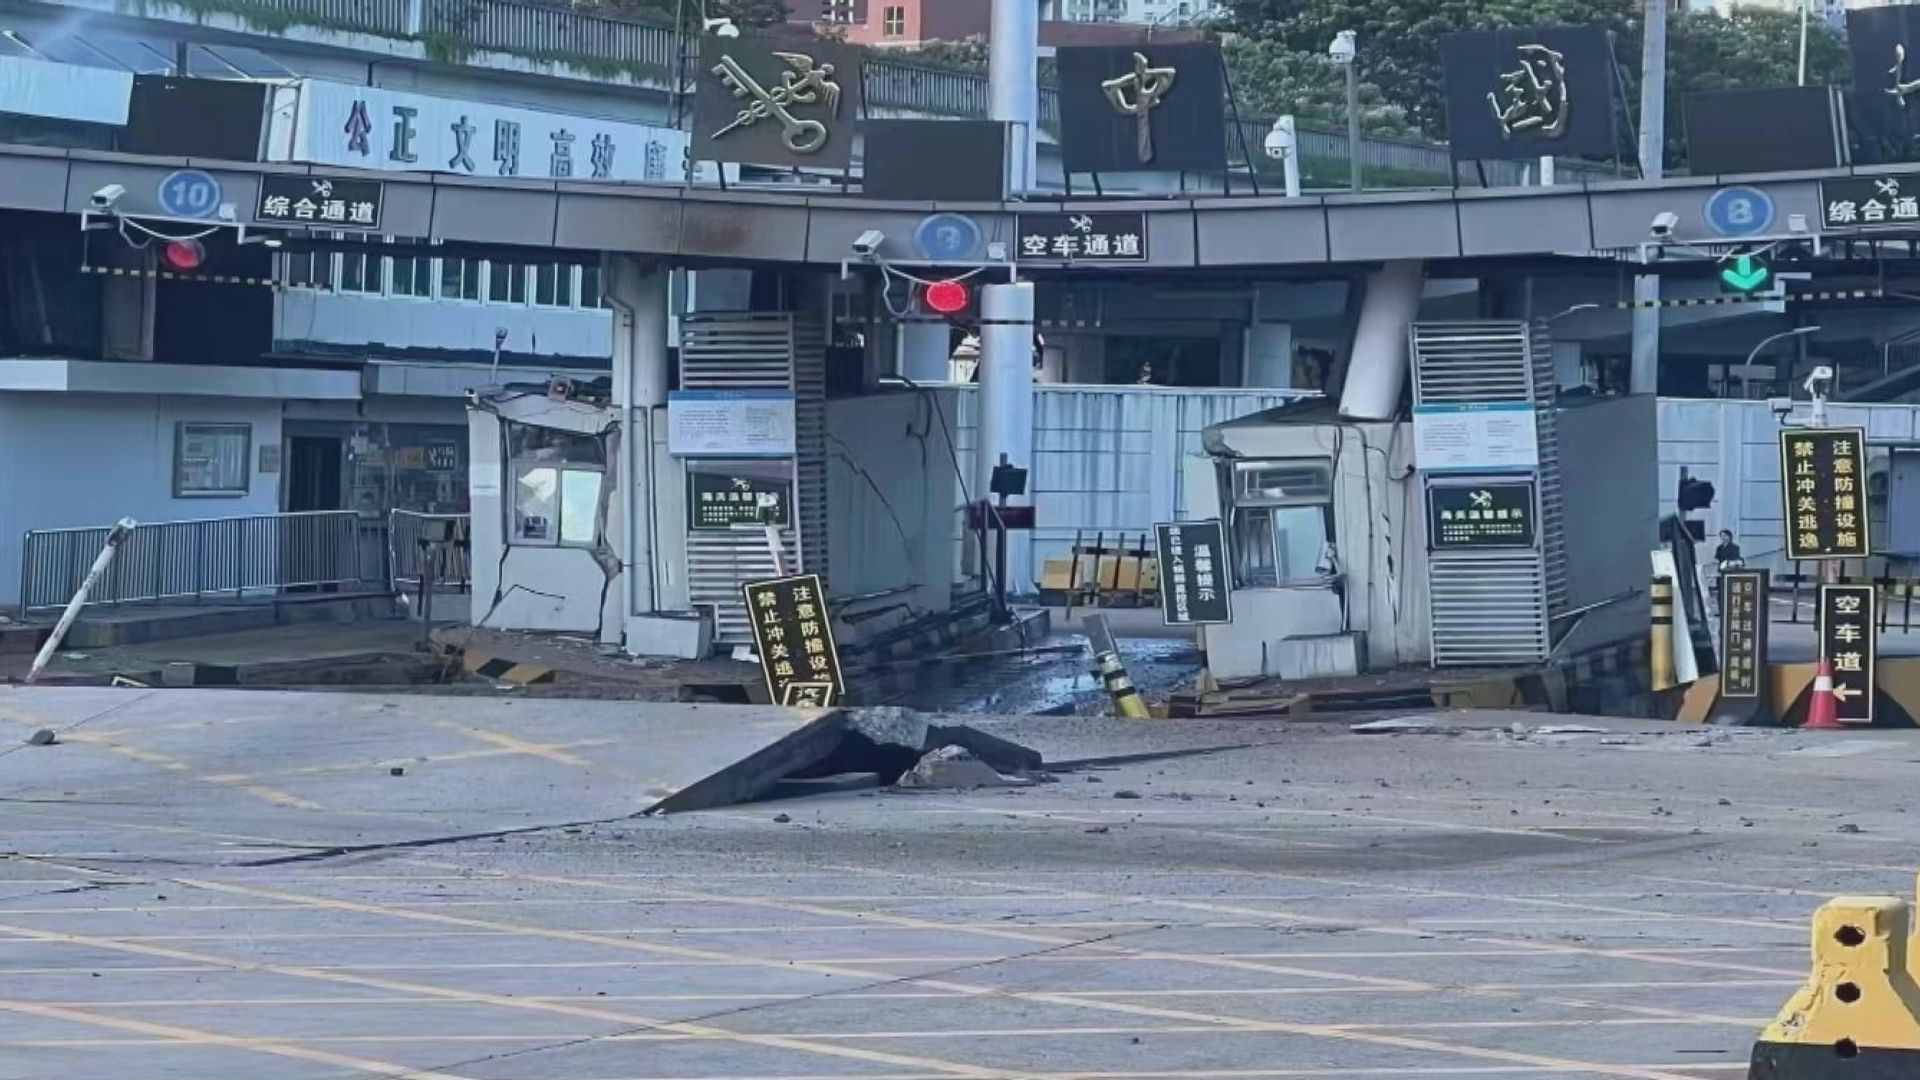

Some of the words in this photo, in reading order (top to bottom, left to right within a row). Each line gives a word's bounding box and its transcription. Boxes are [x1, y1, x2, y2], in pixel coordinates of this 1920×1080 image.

[1101, 51, 1177, 162] 中
[173, 180, 209, 207] 10
[263, 195, 375, 224] 综合通道
[1828, 196, 1920, 222] 综合通
[1022, 233, 1140, 258] 空车通道
[1793, 441, 1819, 549] 禁止冲关逃逸
[1832, 440, 1857, 548] 注意防撞设施
[1833, 595, 1863, 672] 空车道
